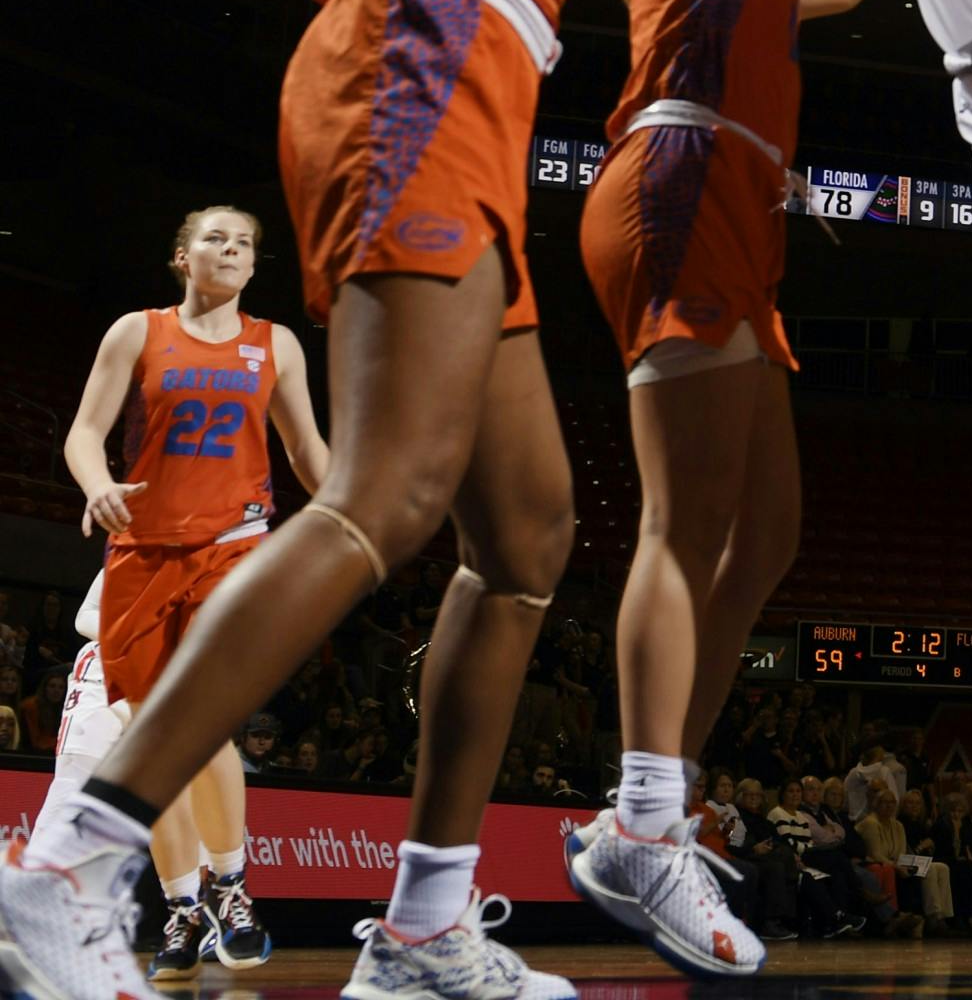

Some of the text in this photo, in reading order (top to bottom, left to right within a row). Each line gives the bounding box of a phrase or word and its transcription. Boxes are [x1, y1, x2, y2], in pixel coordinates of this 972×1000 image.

[543, 139, 568, 155] FGM
[583, 143, 605, 159] FGA
[538, 158, 568, 183] 23
[823, 169, 869, 189] FLORIDA
[916, 180, 938, 196] 3PM
[952, 184, 972, 199] 3PA
[821, 188, 852, 217] 78
[919, 200, 934, 222] 9
[161, 367, 261, 394] GATORS
[164, 398, 246, 459] 22
[813, 625, 857, 642] AUBURN
[891, 630, 941, 655] 2:12
[814, 649, 843, 672] 59
[881, 663, 926, 678] PERIOD 4
[954, 666, 961, 678] B
[244, 826, 395, 869] tar with the
